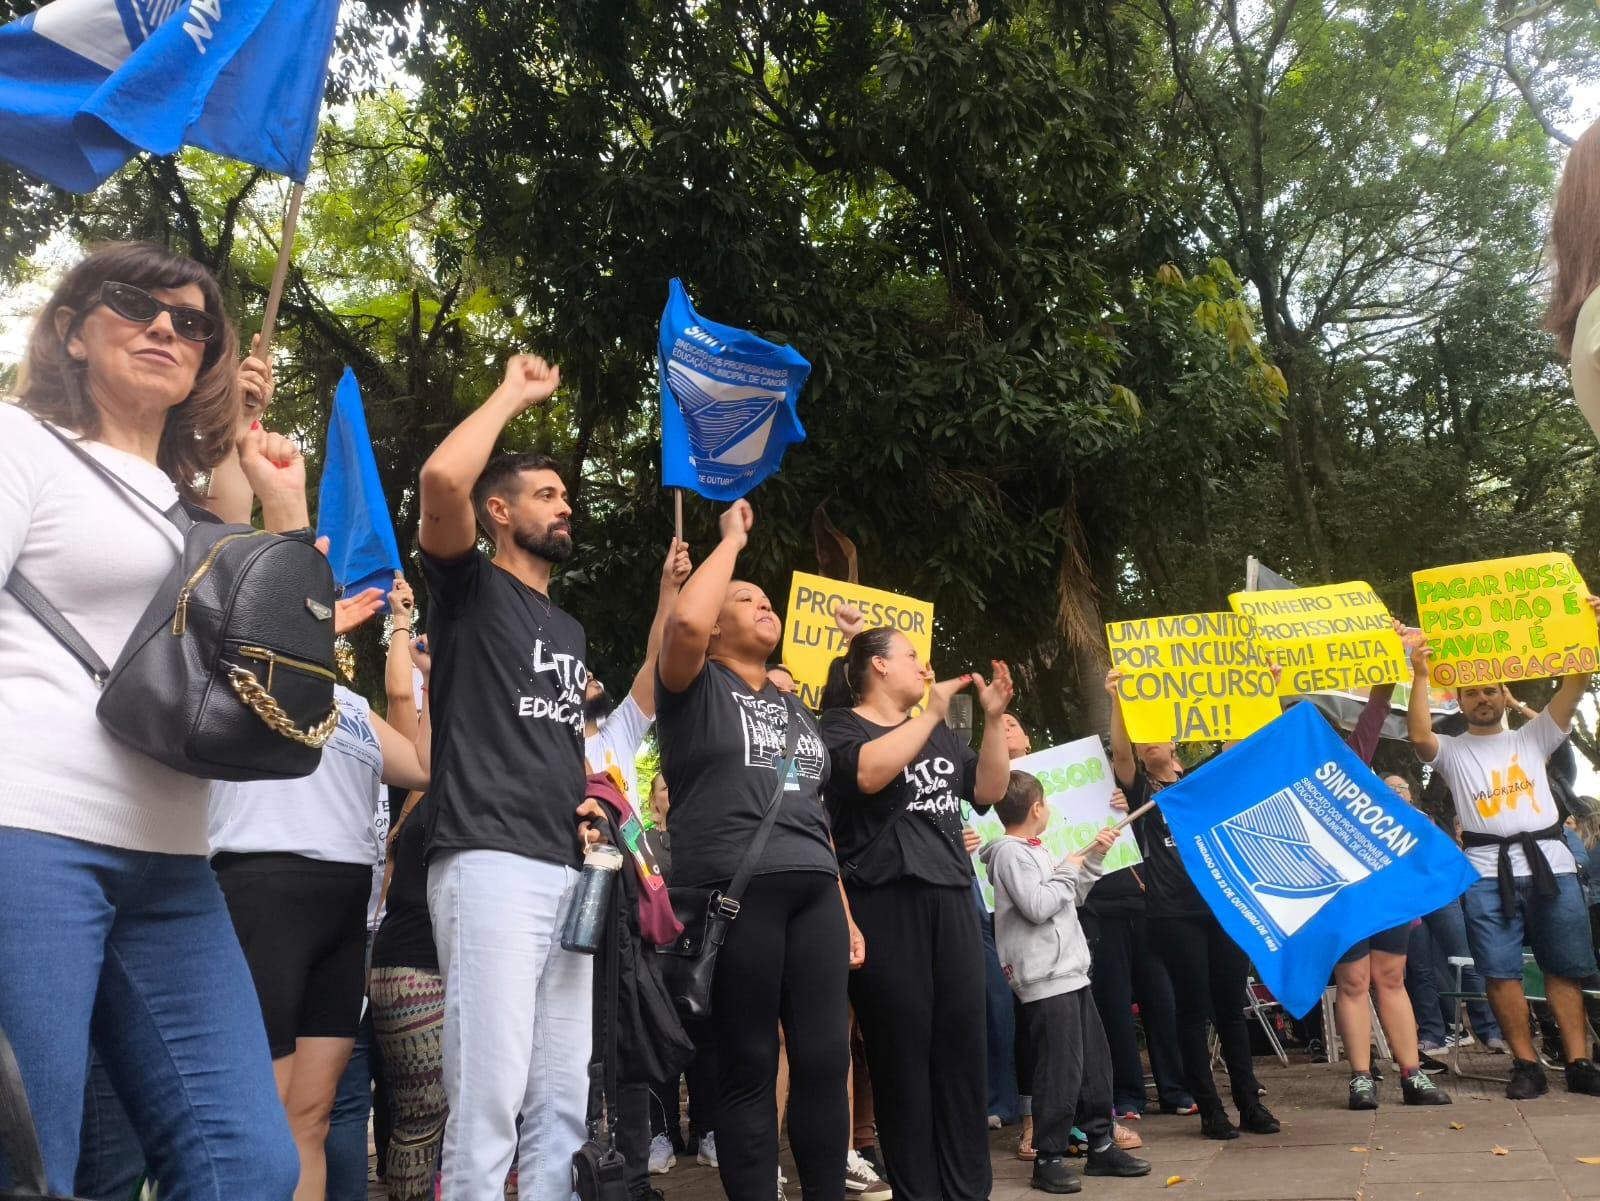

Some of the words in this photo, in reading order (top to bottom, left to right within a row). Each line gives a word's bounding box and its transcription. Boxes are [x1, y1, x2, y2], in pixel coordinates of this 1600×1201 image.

[1240, 596, 1333, 617] DINHEIRO
[1416, 575, 1503, 605] PAGAR
[1422, 605, 1482, 634] PISO
[1489, 591, 1552, 623] NÃO
[1562, 584, 1582, 615] É
[1108, 620, 1150, 643] UM
[1112, 645, 1165, 668] POR
[1326, 639, 1389, 663] FALTA
[1116, 667, 1276, 702] CONCURSO
[1293, 659, 1401, 693] GESTÃO!!
[1171, 697, 1233, 743] JÁ!!
[1293, 781, 1326, 818] EDUCAÇÃO
[1301, 777, 1331, 809] SINDICATO
[1329, 805, 1344, 823] DOS
[1315, 761, 1419, 857] SINPROCAN
[1194, 834, 1216, 869] FUNDADO
[1230, 896, 1261, 927] OUTUBRO
